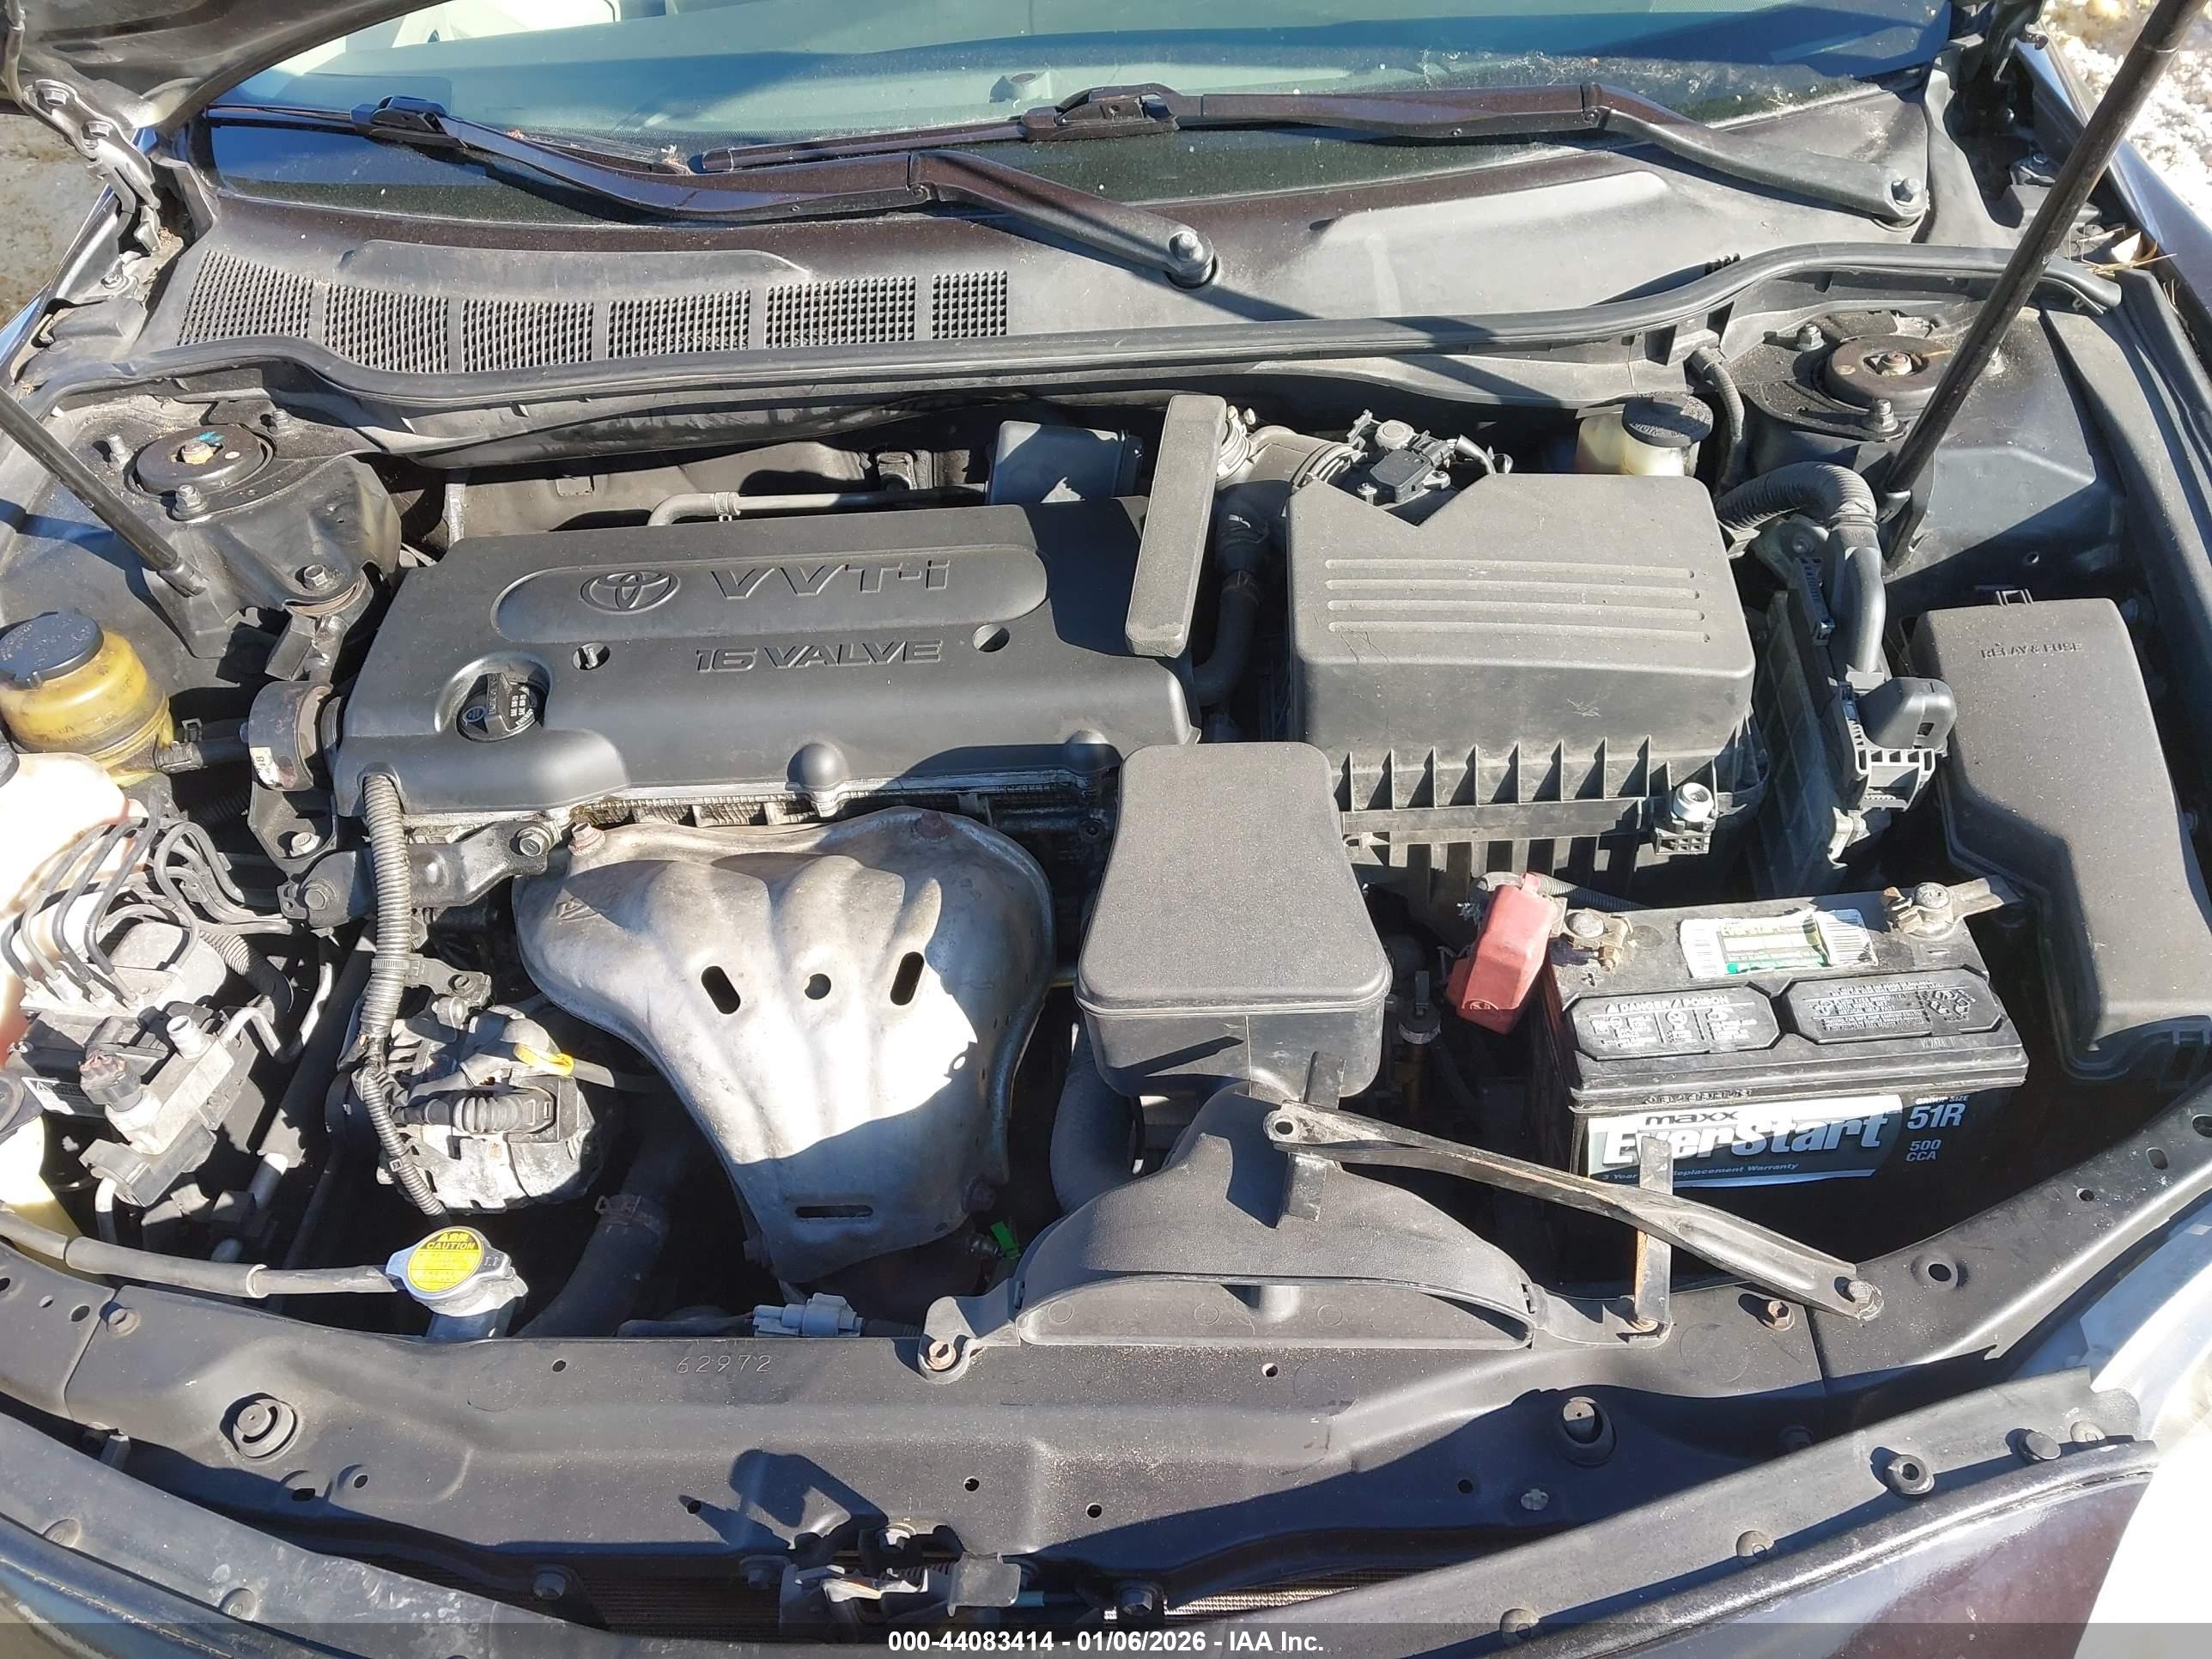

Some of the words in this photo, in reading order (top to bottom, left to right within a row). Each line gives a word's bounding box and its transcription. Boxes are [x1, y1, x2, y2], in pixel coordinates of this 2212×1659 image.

[2043, 642, 2082, 653] FUSE
[696, 646, 757, 673] 16
[764, 639, 944, 669] VALVE
[1644, 1110, 1739, 1126] maxx
[1907, 1103, 1966, 1129] 51R
[1910, 1139, 1942, 1152] 500
[1906, 1151, 1937, 1162] CCA
[1747, 1163, 1799, 1172] Warranty
[676, 1355, 771, 1374] 62972
